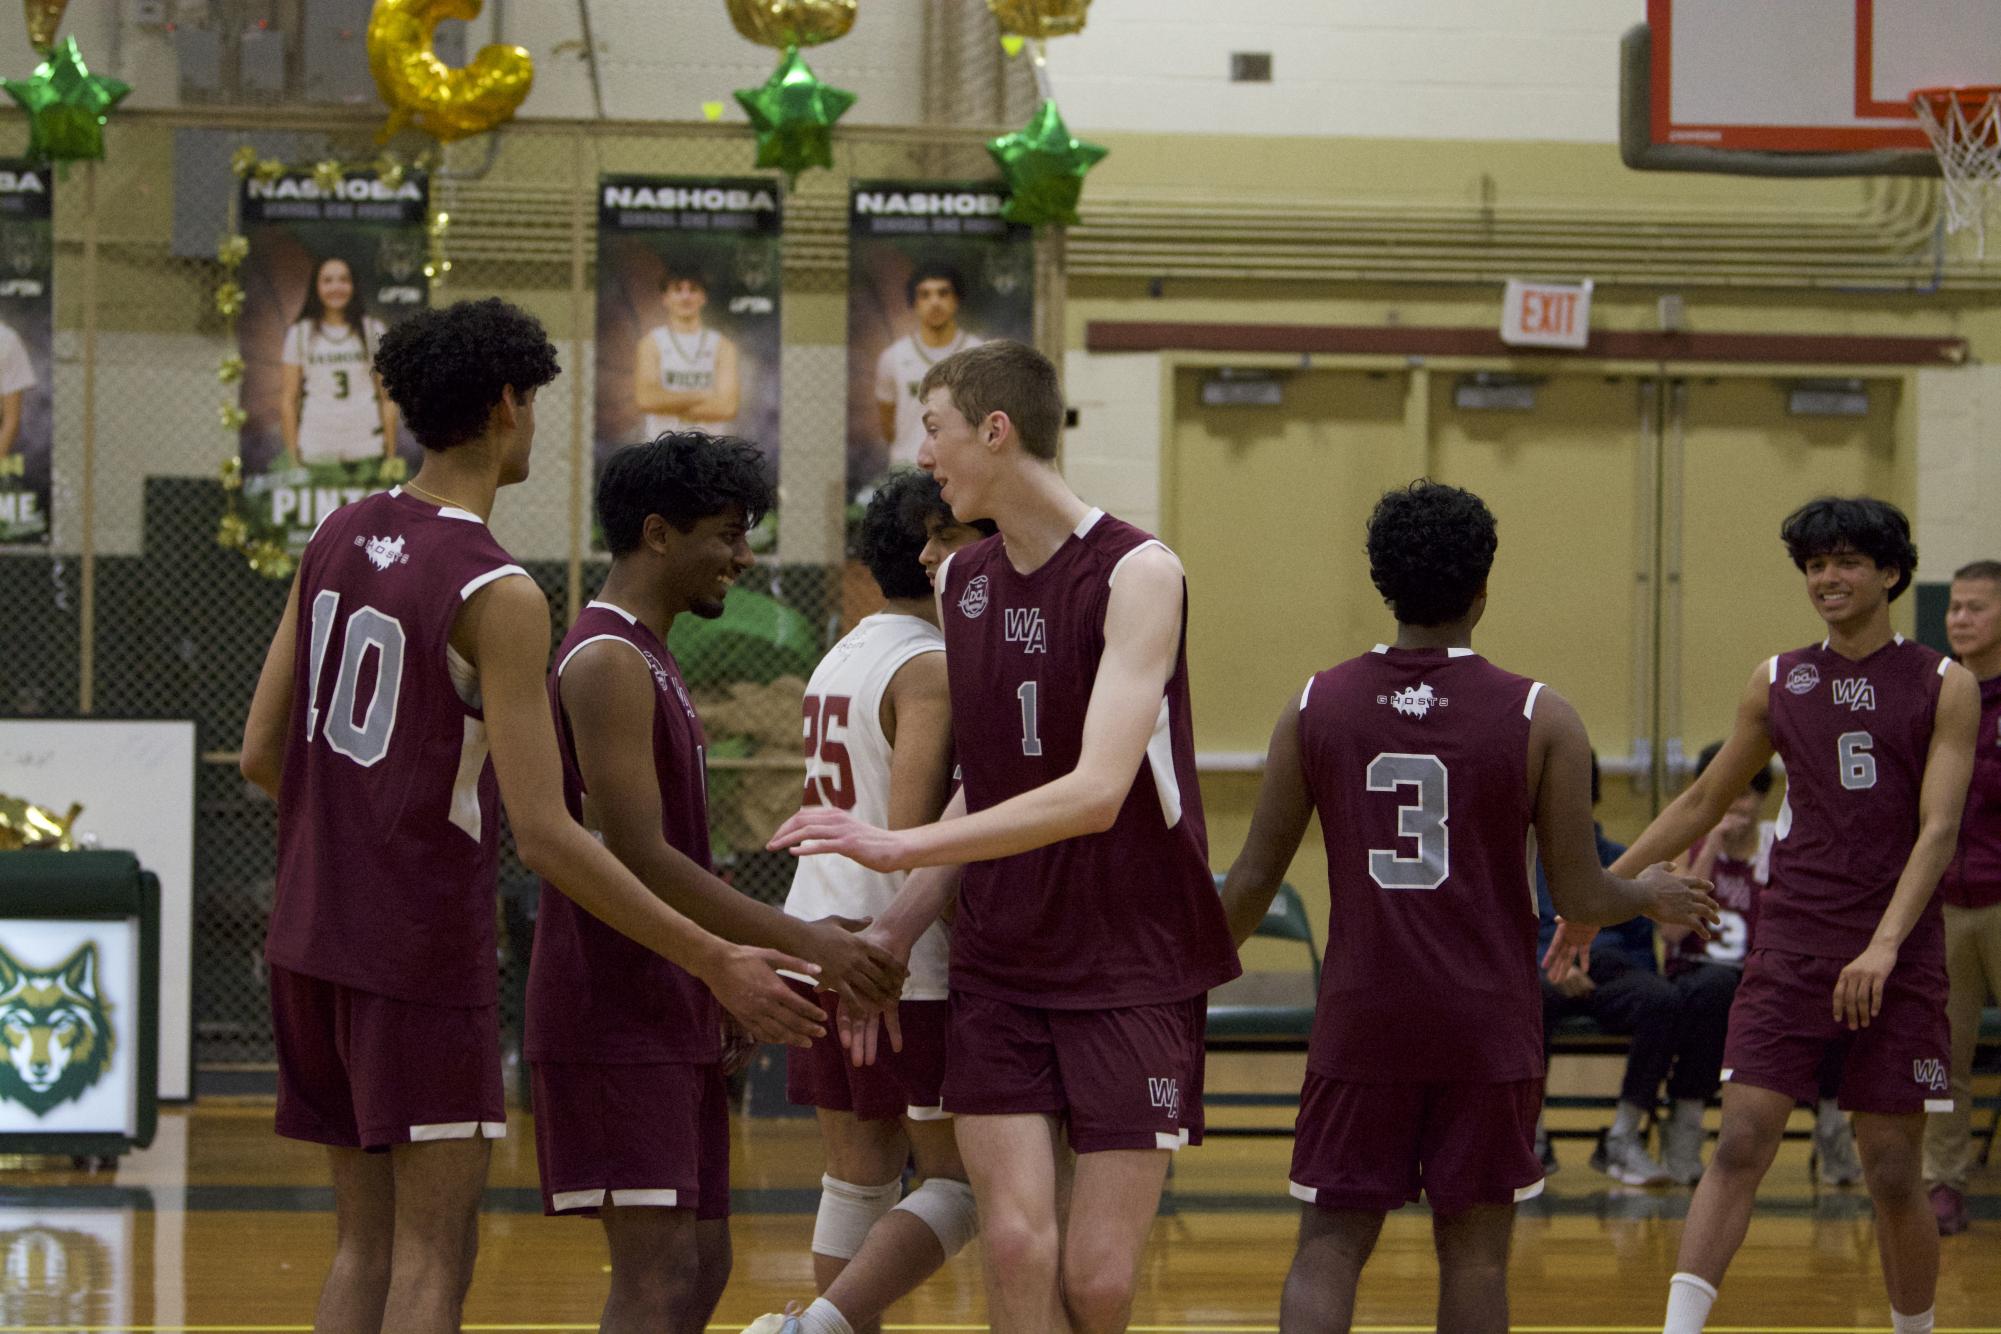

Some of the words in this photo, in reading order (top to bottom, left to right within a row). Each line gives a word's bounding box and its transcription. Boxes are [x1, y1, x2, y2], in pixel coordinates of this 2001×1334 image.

[604, 186, 775, 211] NASHOBA
[856, 192, 1001, 215] NASHOB
[1522, 289, 1578, 336] EXIT
[333, 369, 349, 399] 3
[271, 487, 380, 526] PINT
[354, 535, 410, 565] GHOSTS
[1004, 608, 1047, 654] WA
[306, 589, 406, 767] 10
[1832, 678, 1876, 711] WA
[1017, 681, 1042, 756] 1
[1377, 694, 1449, 707] GHOSTS
[1837, 731, 1877, 790] 6
[1366, 752, 1449, 889] 3
[1913, 1058, 1948, 1090] WA
[1148, 1077, 1179, 1119] WA
